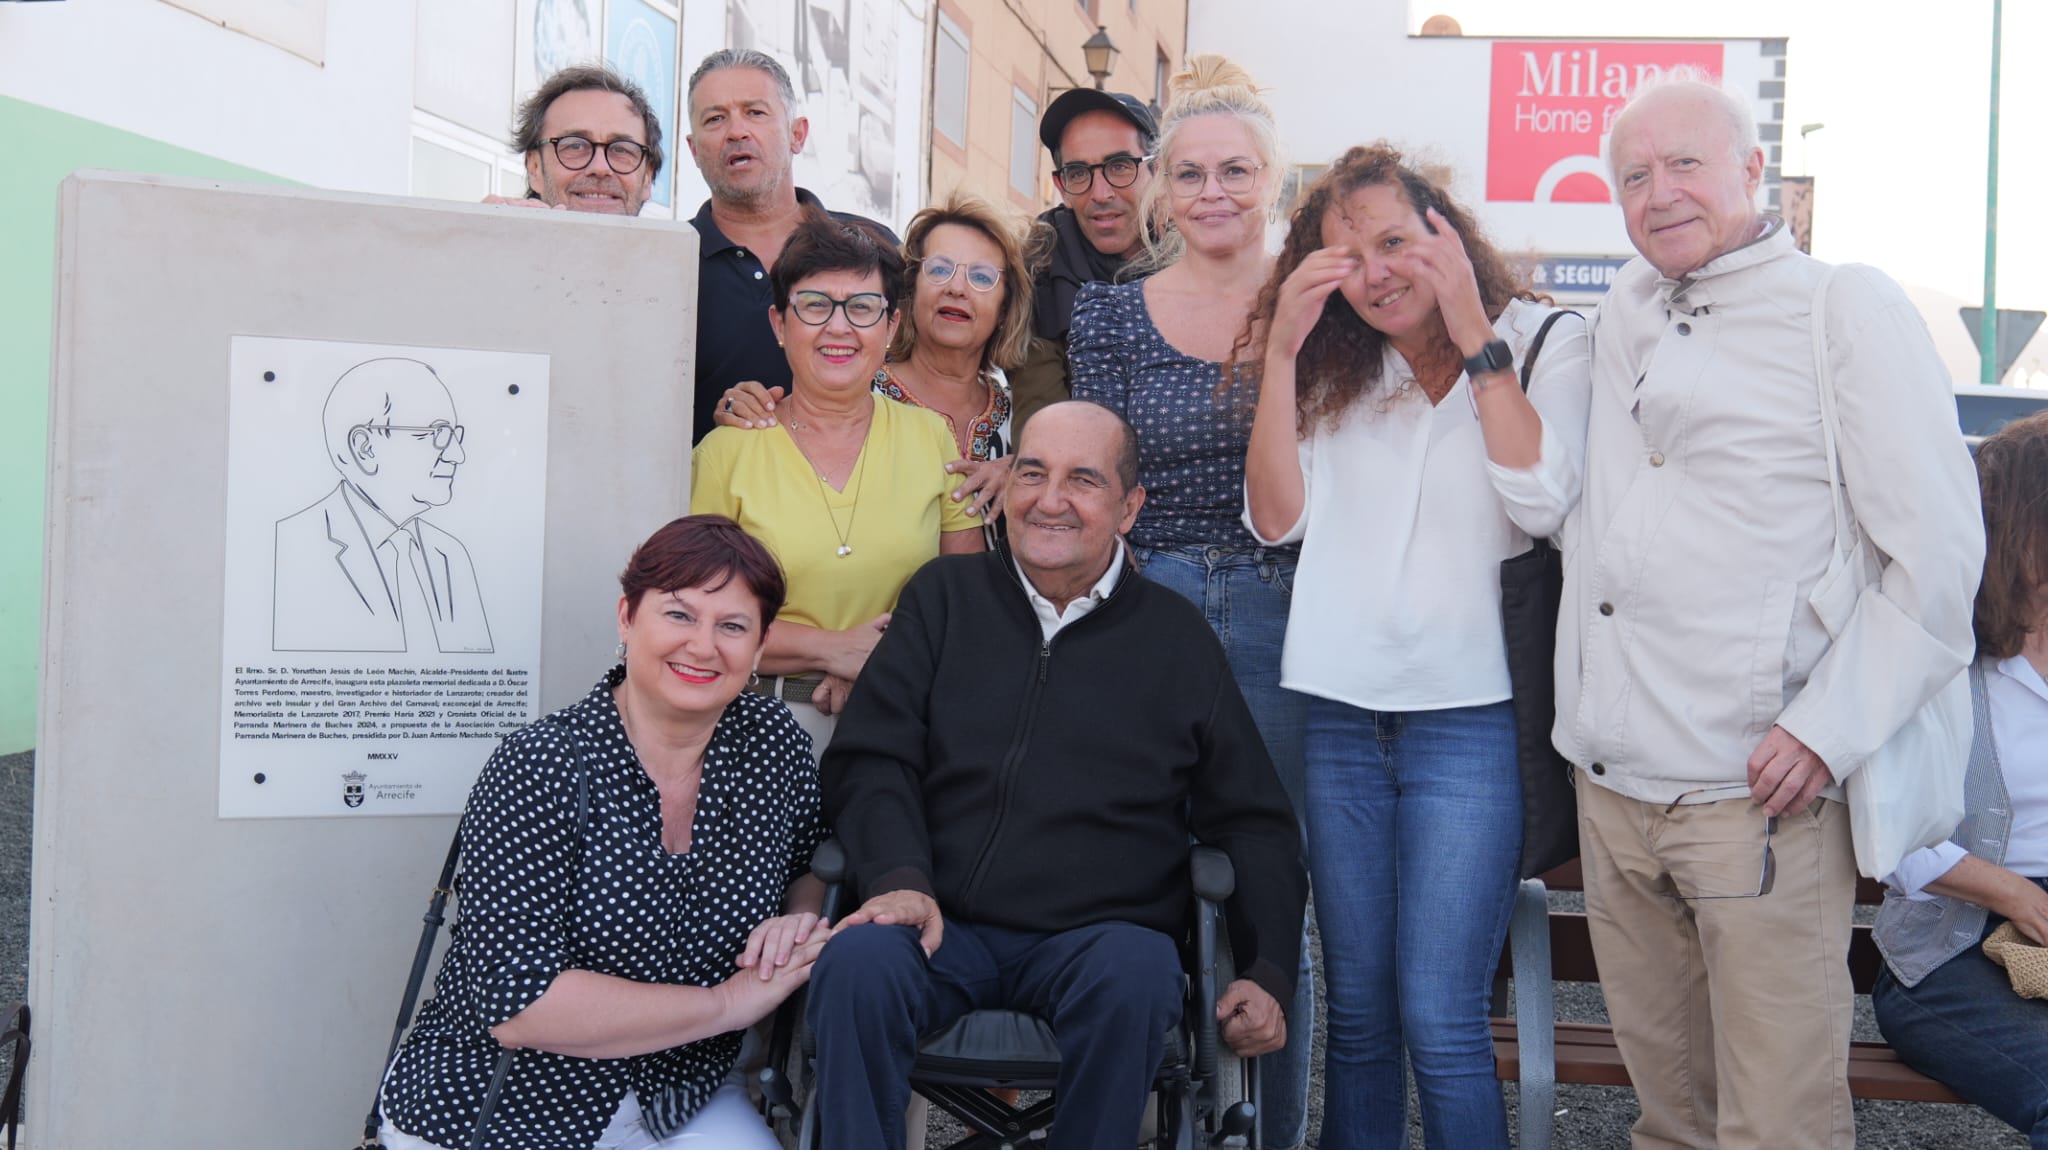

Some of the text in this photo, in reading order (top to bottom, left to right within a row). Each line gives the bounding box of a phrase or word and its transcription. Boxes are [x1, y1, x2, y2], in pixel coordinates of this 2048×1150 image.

[1515, 103, 1592, 133] Home
[291, 667, 327, 675] Yonathan
[329, 667, 351, 675] Jesús
[366, 667, 386, 675] León
[420, 668, 489, 676] Alcalde-Presidente
[234, 677, 288, 686] Ayuntamiento
[300, 677, 334, 686] Arrecife,
[334, 678, 368, 687] inaugura
[386, 678, 421, 687] plazoleta
[457, 678, 491, 687] dedicada
[506, 678, 528, 687] Óscar
[234, 688, 259, 696] Torres
[261, 688, 298, 697] Perdomo,
[335, 689, 382, 698] investigador
[391, 689, 432, 697] historiador
[486, 689, 514, 697] creador
[234, 699, 263, 707] archivo
[265, 699, 282, 707] web
[285, 699, 311, 707] insular
[337, 699, 357, 707] Gran
[359, 699, 388, 707] Archivo
[442, 700, 482, 708] exconcejal
[234, 710, 284, 718] Memorialista
[301, 710, 339, 718] Lanzarote
[364, 710, 391, 718] Premio
[418, 710, 436, 718] 2021
[446, 710, 477, 718] Cronista
[480, 710, 505, 718] Oficial
[233, 721, 269, 729] Parranda
[273, 721, 308, 729] Marinera
[325, 721, 353, 729] Buches
[390, 721, 428, 730] propuesta
[455, 721, 495, 729] Asociación
[234, 731, 270, 740] Parranda
[271, 731, 306, 740] Marinera
[351, 731, 387, 741] presidida
[411, 731, 429, 739] Juan
[429, 731, 458, 739] Antonio
[459, 731, 493, 739] Machado
[368, 783, 412, 791] Ayuntamiento
[376, 790, 416, 800] Arrecife
